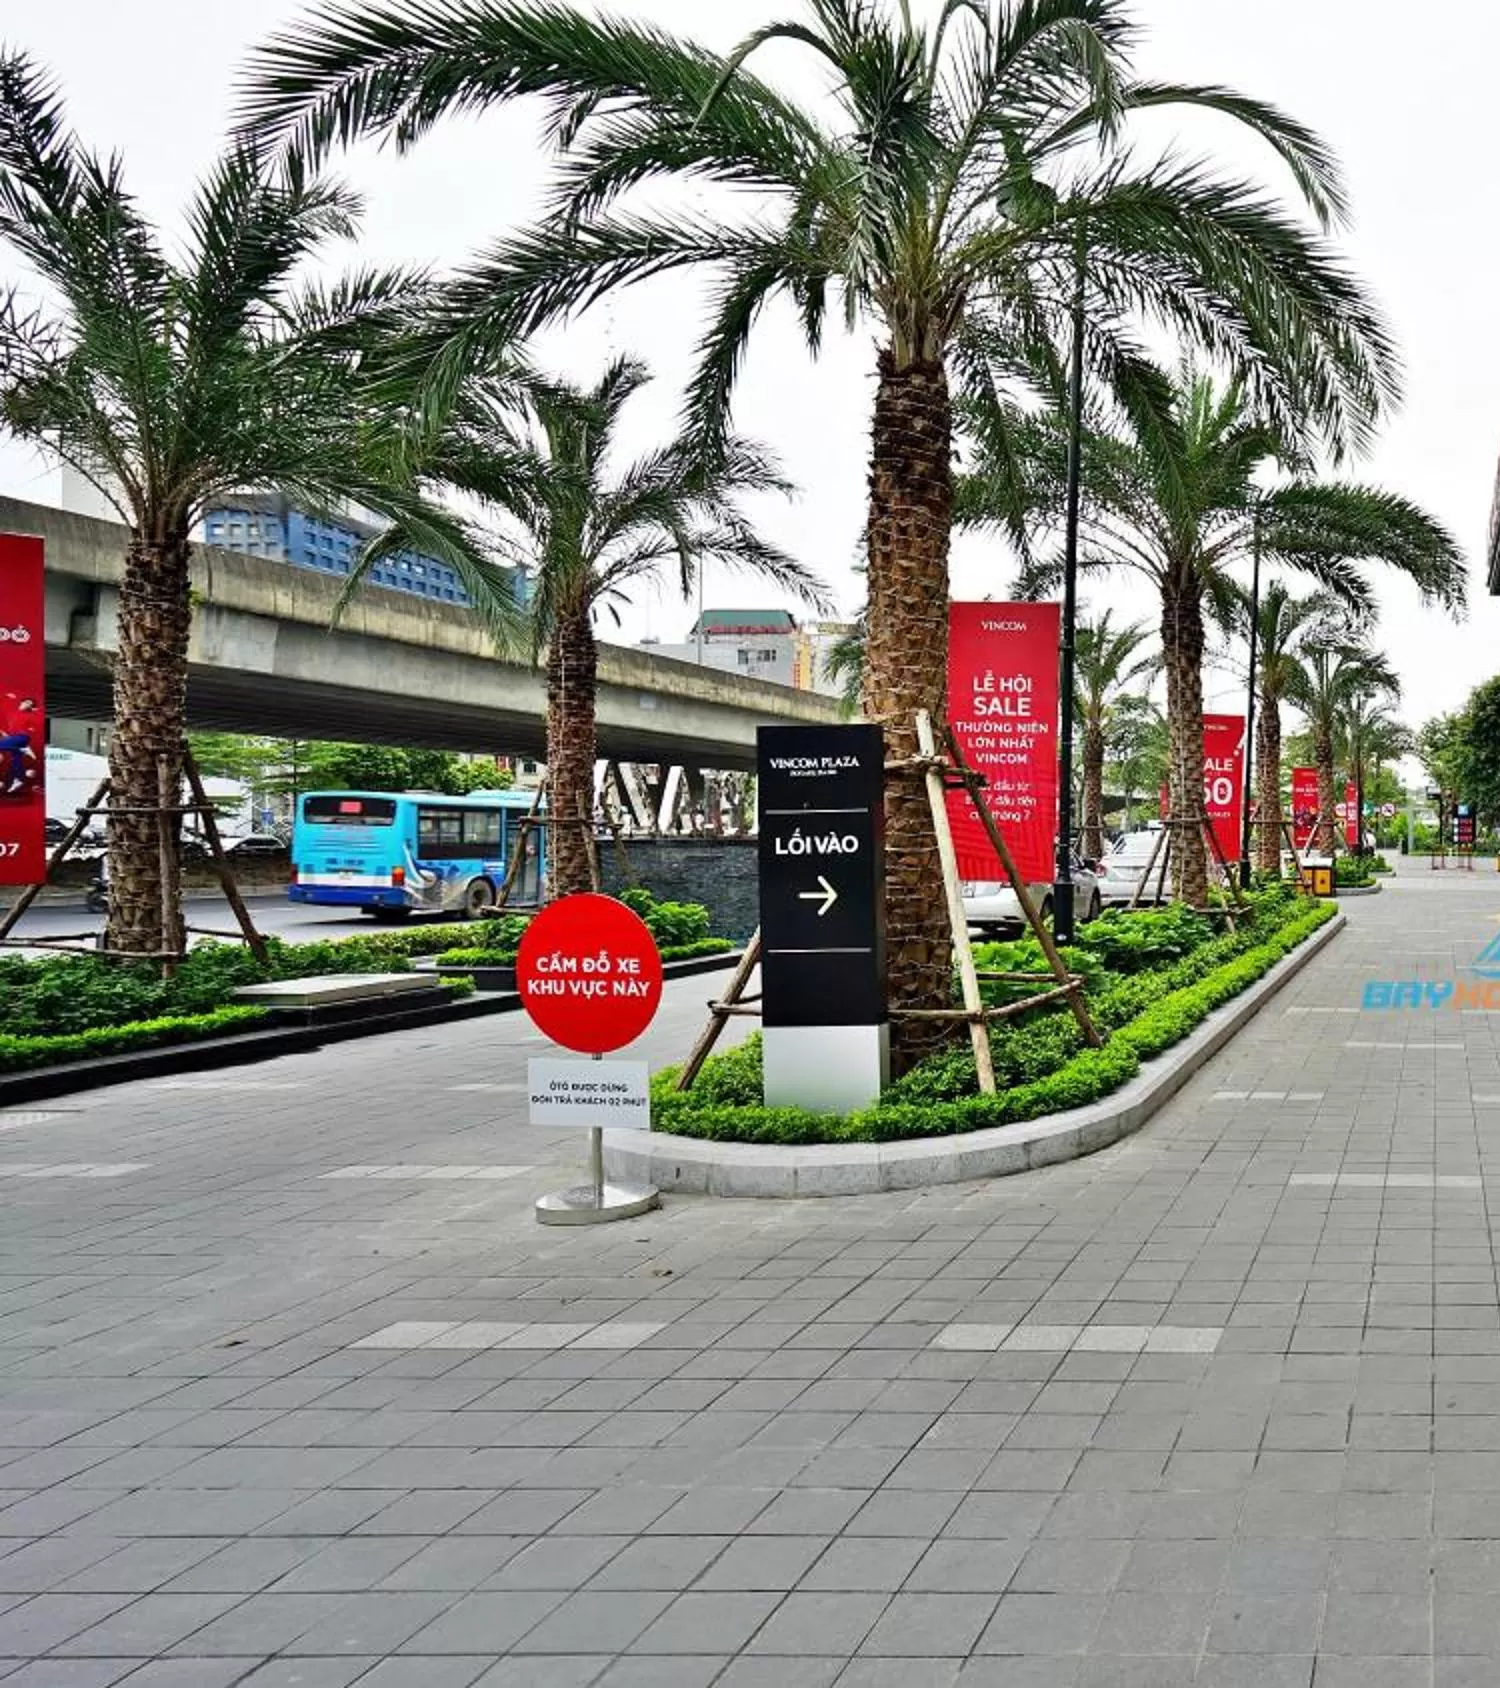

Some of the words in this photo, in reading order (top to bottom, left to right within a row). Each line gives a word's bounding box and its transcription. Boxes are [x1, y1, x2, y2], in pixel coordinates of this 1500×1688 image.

[981, 620, 1027, 631] VINCOM
[973, 696, 1032, 717] SALE
[769, 757, 820, 769] VINCOM
[821, 755, 860, 769] PLAZA
[975, 753, 1028, 765] VINCOM
[1203, 757, 1234, 772] ALE
[775, 826, 812, 855] LỐI
[813, 831, 860, 855] VÀO
[536, 950, 577, 973] CẤM
[582, 949, 611, 973] ĐỖ
[616, 958, 641, 974] XE
[527, 979, 565, 995] KHU
[568, 979, 608, 1000] VỰC
[612, 976, 650, 997] NÀY
